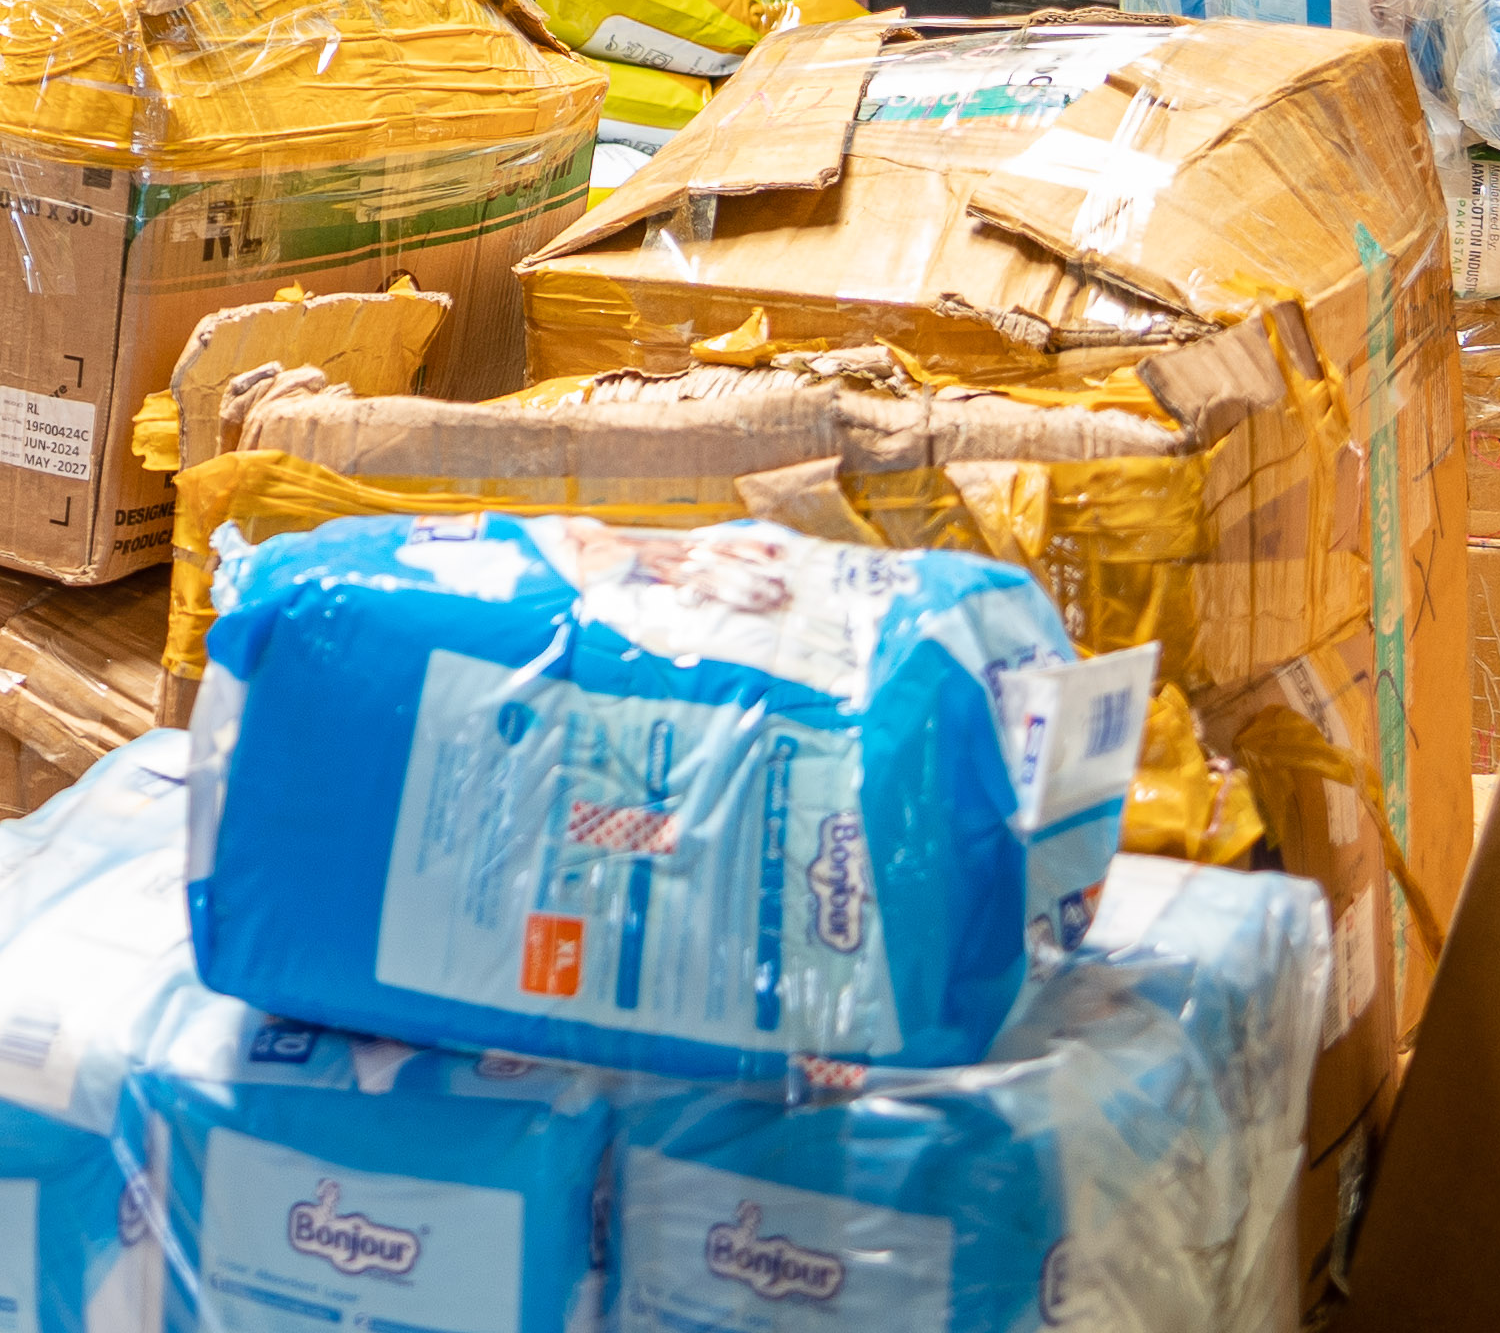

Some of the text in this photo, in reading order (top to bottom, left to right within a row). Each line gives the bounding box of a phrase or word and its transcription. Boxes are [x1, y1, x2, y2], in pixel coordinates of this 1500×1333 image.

[1452, 198, 1466, 276] PAKISTAN
[26, 401, 40, 416] RL
[25, 419, 89, 442] 19F00424C
[24, 437, 80, 457] JUN-2024
[23, 453, 49, 469] MAY
[291, 1211, 417, 1275] Bonjour
[709, 1235, 844, 1299] Bonjour
